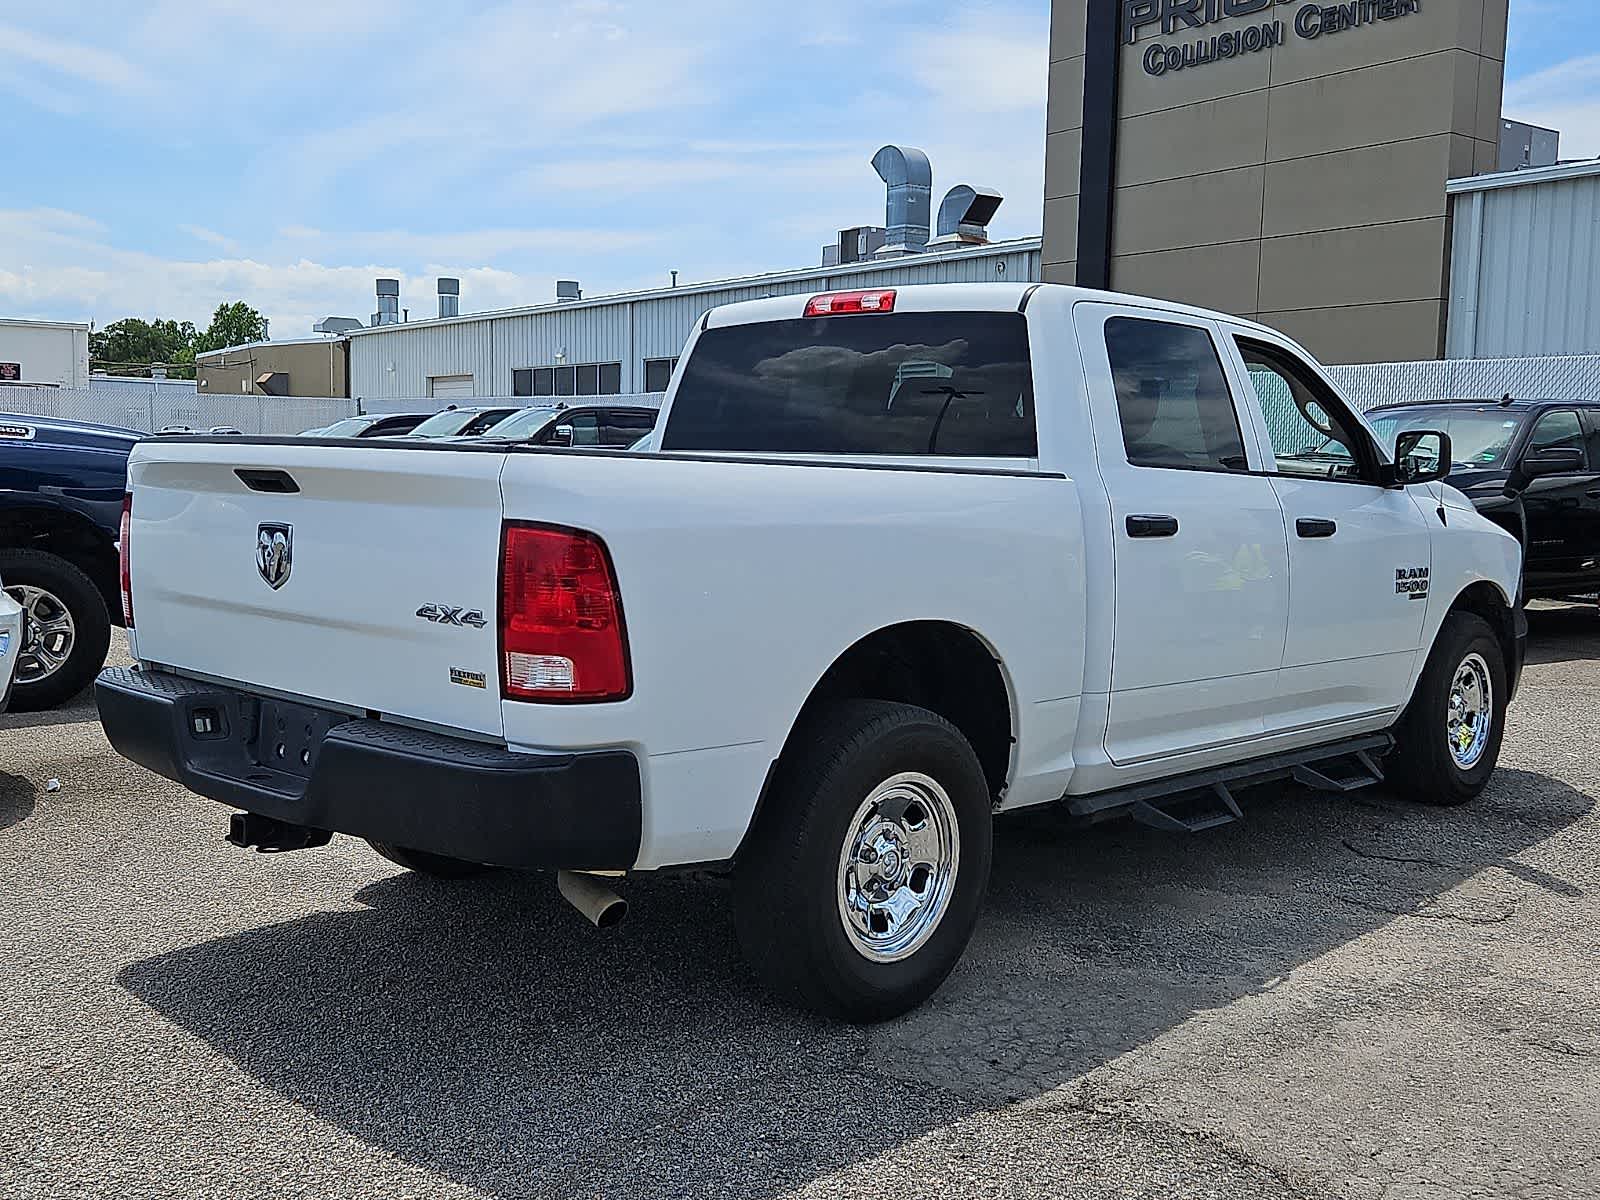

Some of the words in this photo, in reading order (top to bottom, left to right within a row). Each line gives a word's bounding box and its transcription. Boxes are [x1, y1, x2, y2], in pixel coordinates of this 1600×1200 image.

[1143, 20, 1282, 76] COLLISION
[1395, 567, 1429, 580] RAM
[1395, 579, 1429, 593] 1500
